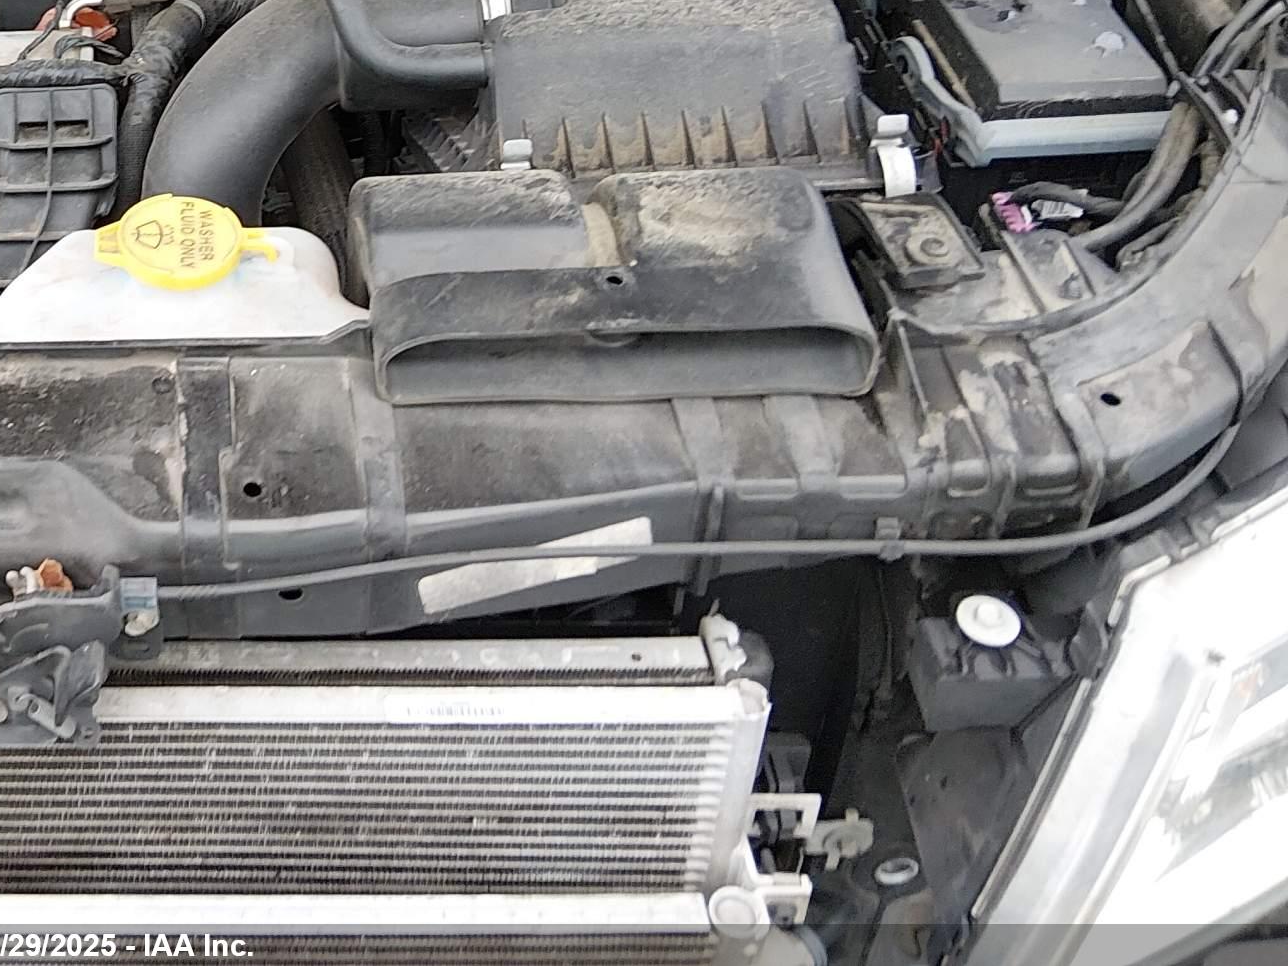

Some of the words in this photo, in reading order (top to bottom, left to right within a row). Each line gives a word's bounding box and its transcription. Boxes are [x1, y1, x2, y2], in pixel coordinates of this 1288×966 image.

[180, 201, 196, 235] FLUID
[199, 209, 215, 261] WASHER
[180, 237, 196, 268] ONLY
